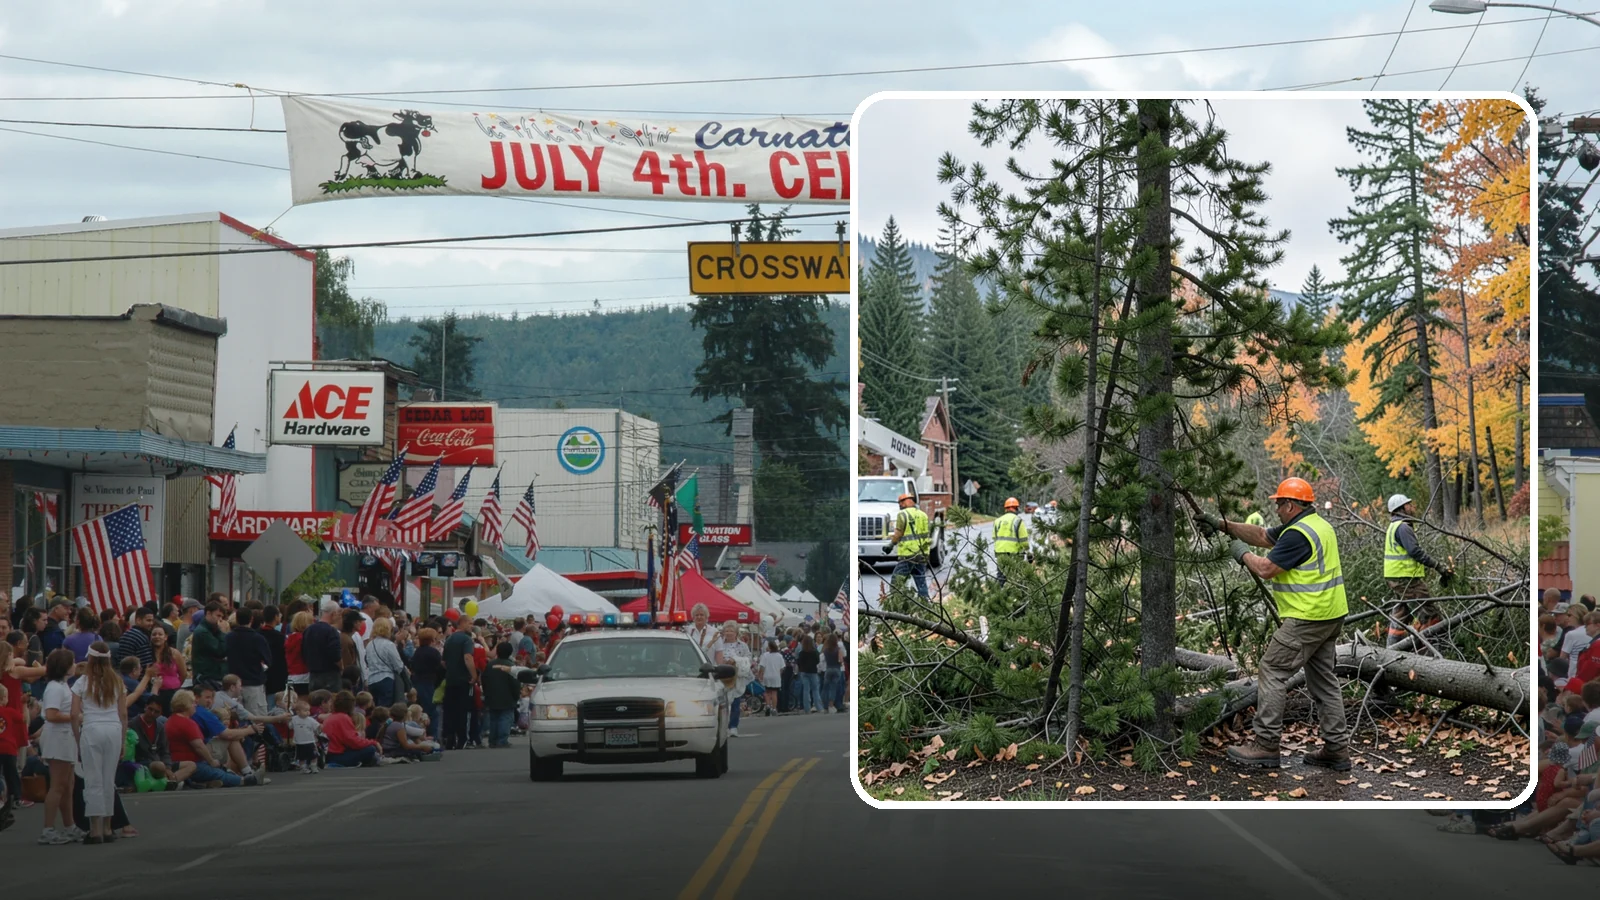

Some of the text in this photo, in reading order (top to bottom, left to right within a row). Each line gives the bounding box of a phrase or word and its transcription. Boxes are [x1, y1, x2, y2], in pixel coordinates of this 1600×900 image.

[481, 141, 605, 192] JULY
[632, 150, 746, 198] 4th.
[697, 254, 850, 280] CROSSWA
[283, 380, 374, 420] ACE
[406, 409, 453, 422] CEDAR
[284, 421, 371, 437] Hardware
[416, 428, 477, 447] Coca-Cola
[96, 485, 124, 494] Vincent
[126, 486, 136, 494] de
[137, 486, 155, 495] Paul
[688, 527, 741, 535] CRNATION
[699, 535, 730, 543] GLASS
